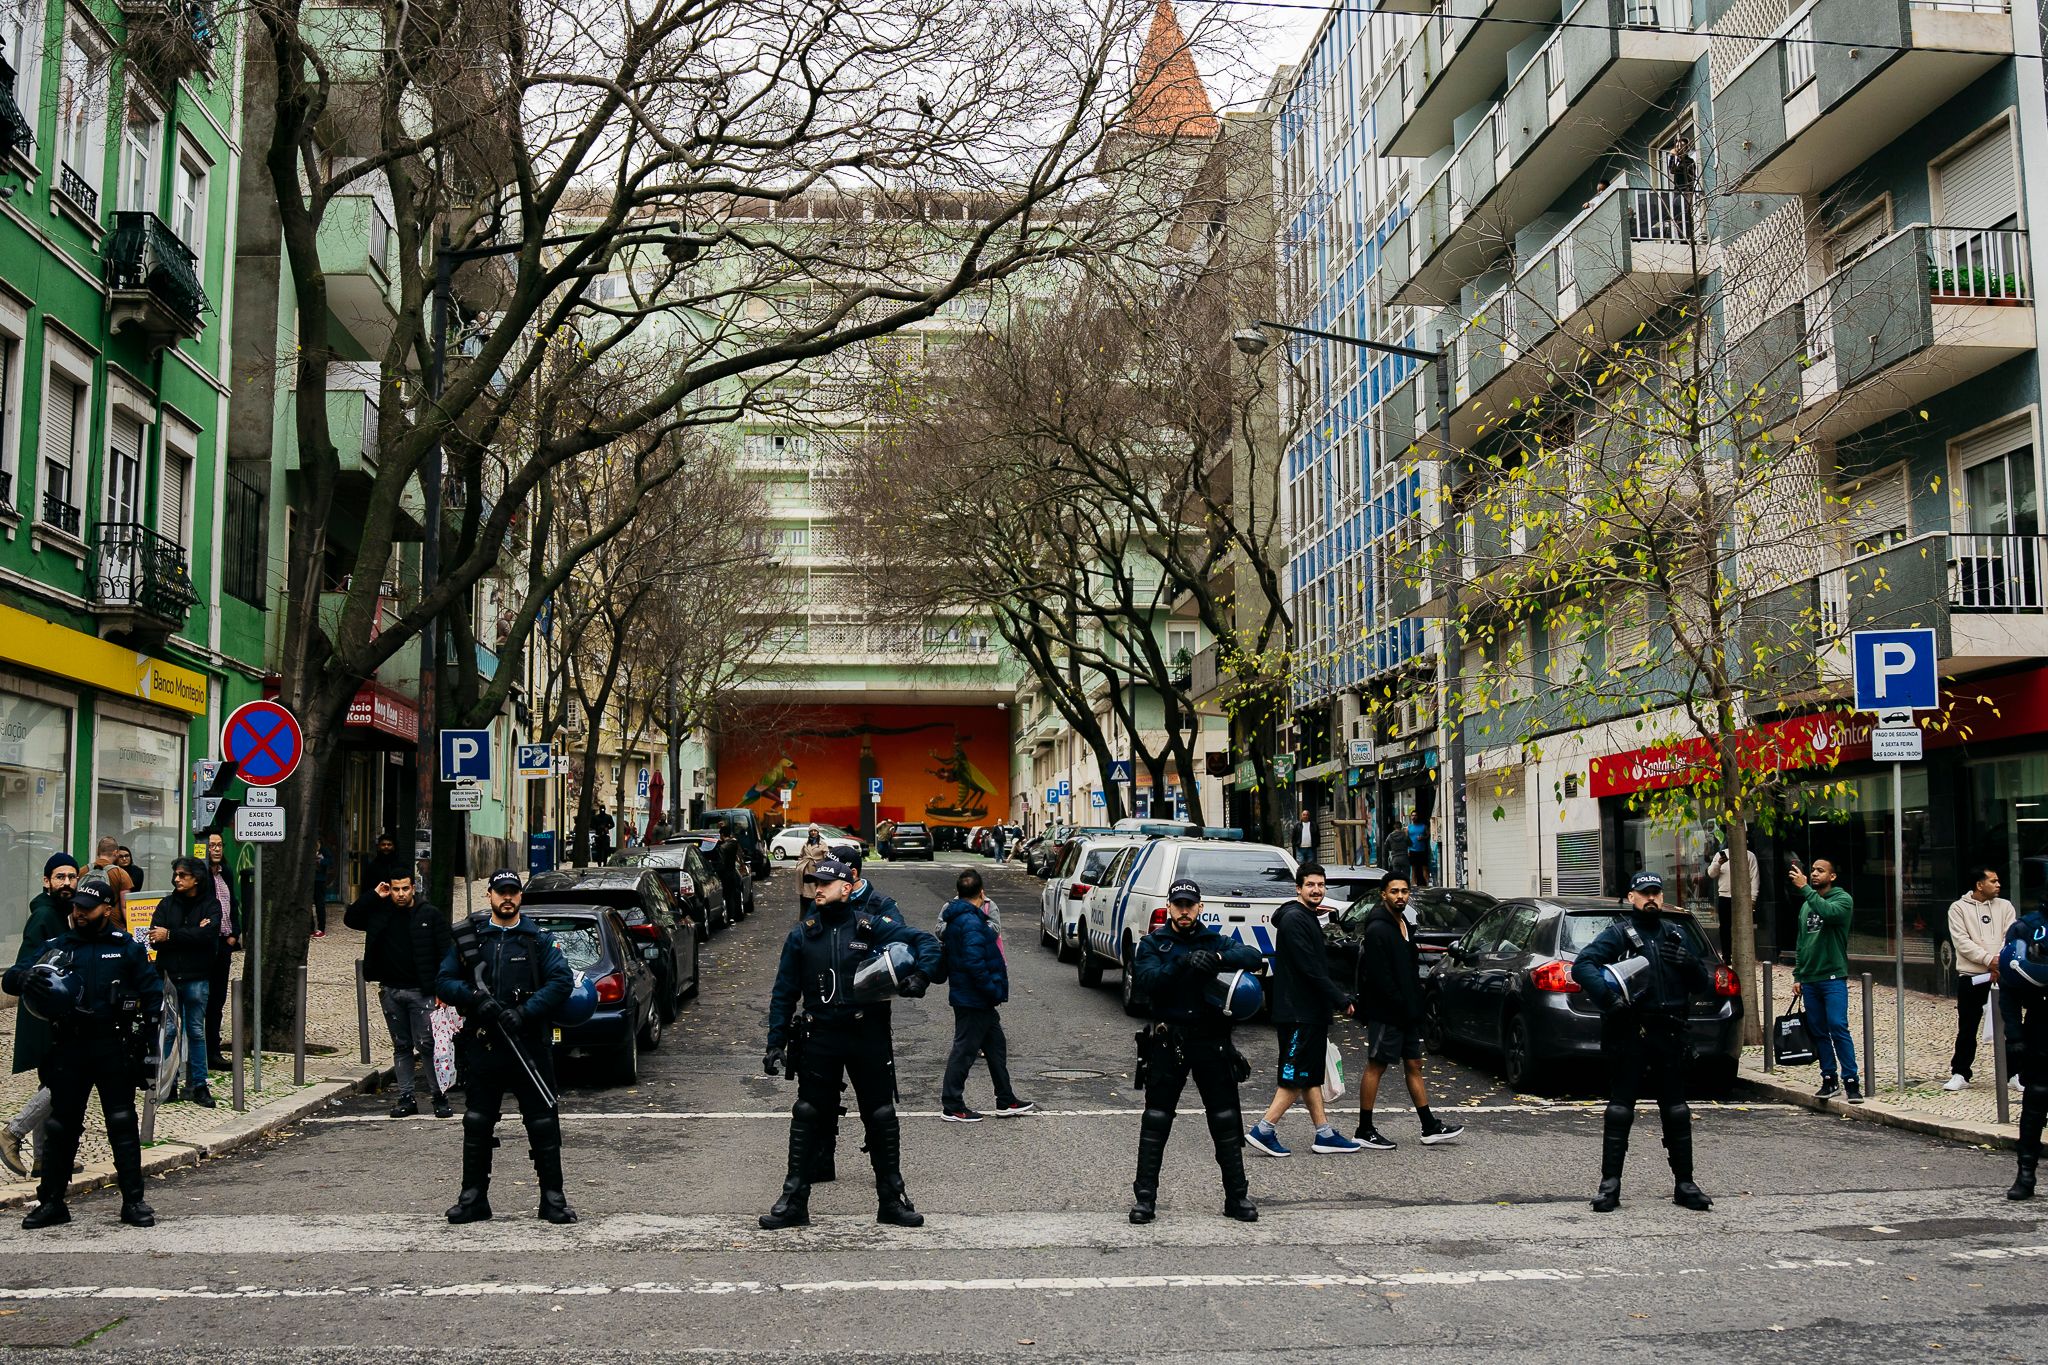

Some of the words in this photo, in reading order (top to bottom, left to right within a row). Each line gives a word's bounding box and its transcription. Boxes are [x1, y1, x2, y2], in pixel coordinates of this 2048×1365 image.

[1873, 642, 1916, 698] P
[153, 670, 175, 694] Banco
[175, 678, 205, 705] Montepio
[346, 712, 372, 724] Kong
[1829, 723, 1879, 748] Santan
[452, 737, 479, 773] P
[521, 747, 533, 764] P
[639, 783, 646, 793] P
[871, 780, 880, 792] P
[1061, 782, 1069, 794] P
[1050, 790, 1057, 802] P
[493, 871, 518, 882] POLÍCIA
[1171, 883, 1197, 894] POLÍCIA
